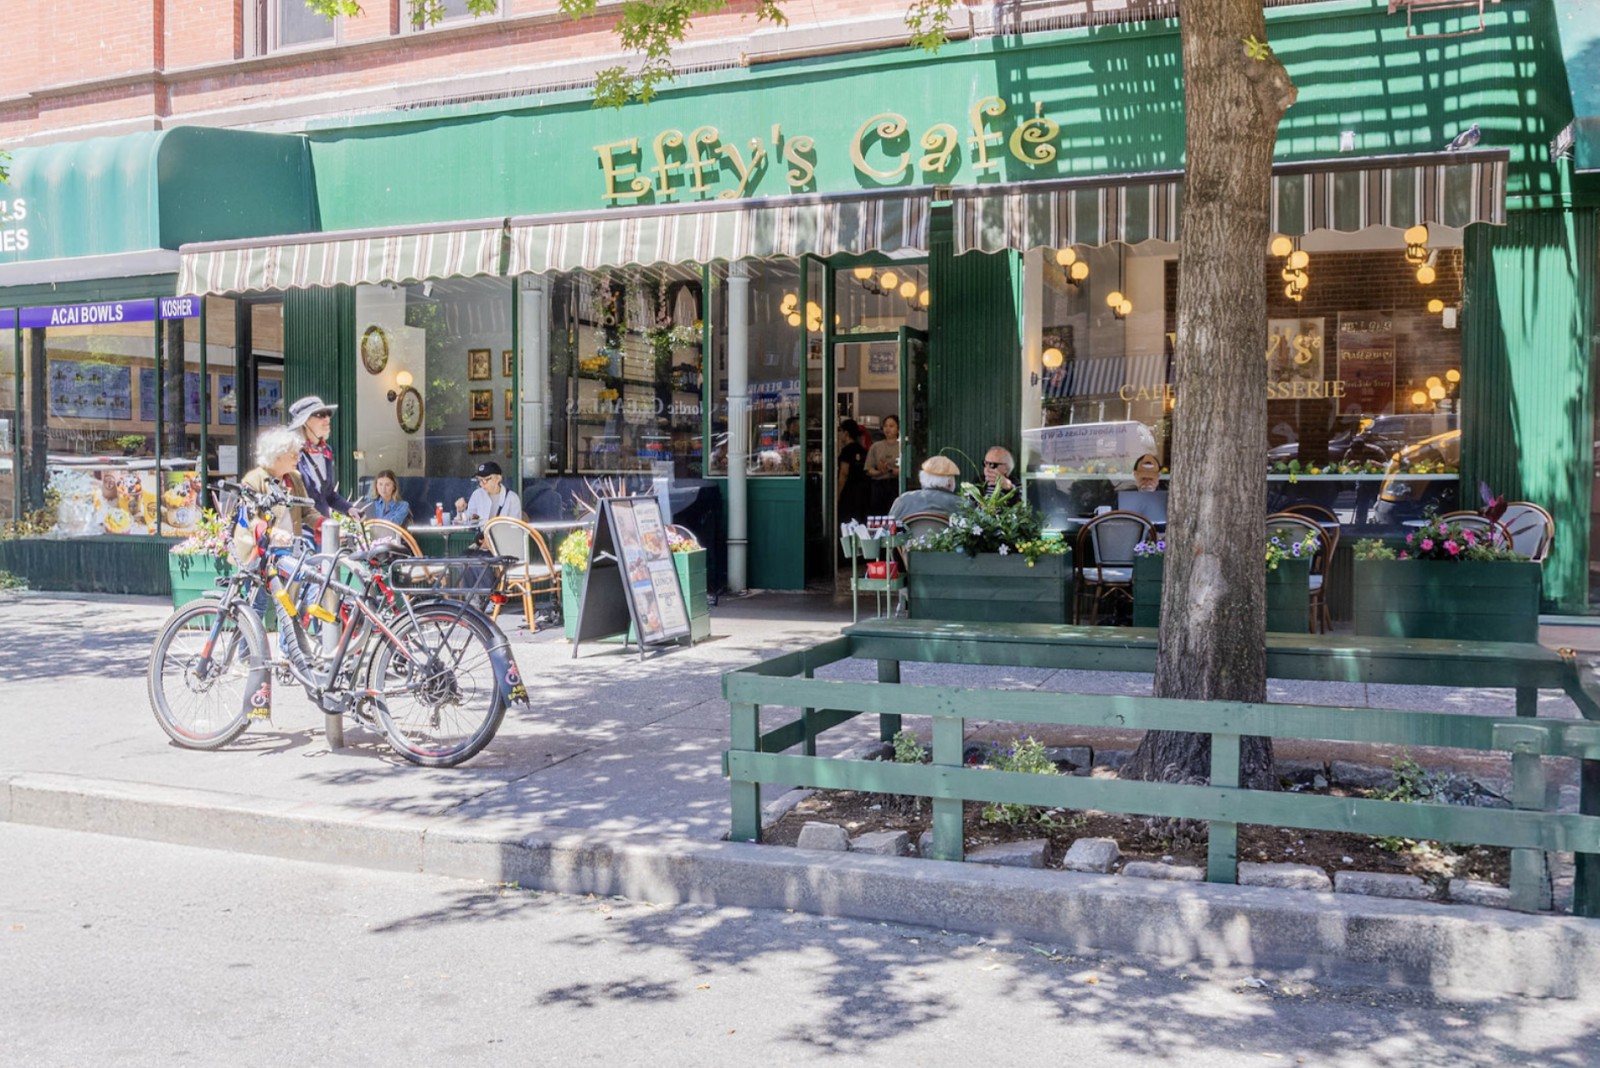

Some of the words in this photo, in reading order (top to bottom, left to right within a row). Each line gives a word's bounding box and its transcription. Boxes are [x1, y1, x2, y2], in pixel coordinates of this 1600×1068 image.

[593, 123, 817, 200] Effy's
[51, 307, 78, 325] ACAI
[81, 304, 124, 323] BOWLS
[162, 298, 192, 317] KOSHER
[1266, 380, 1347, 399] SSERIE
